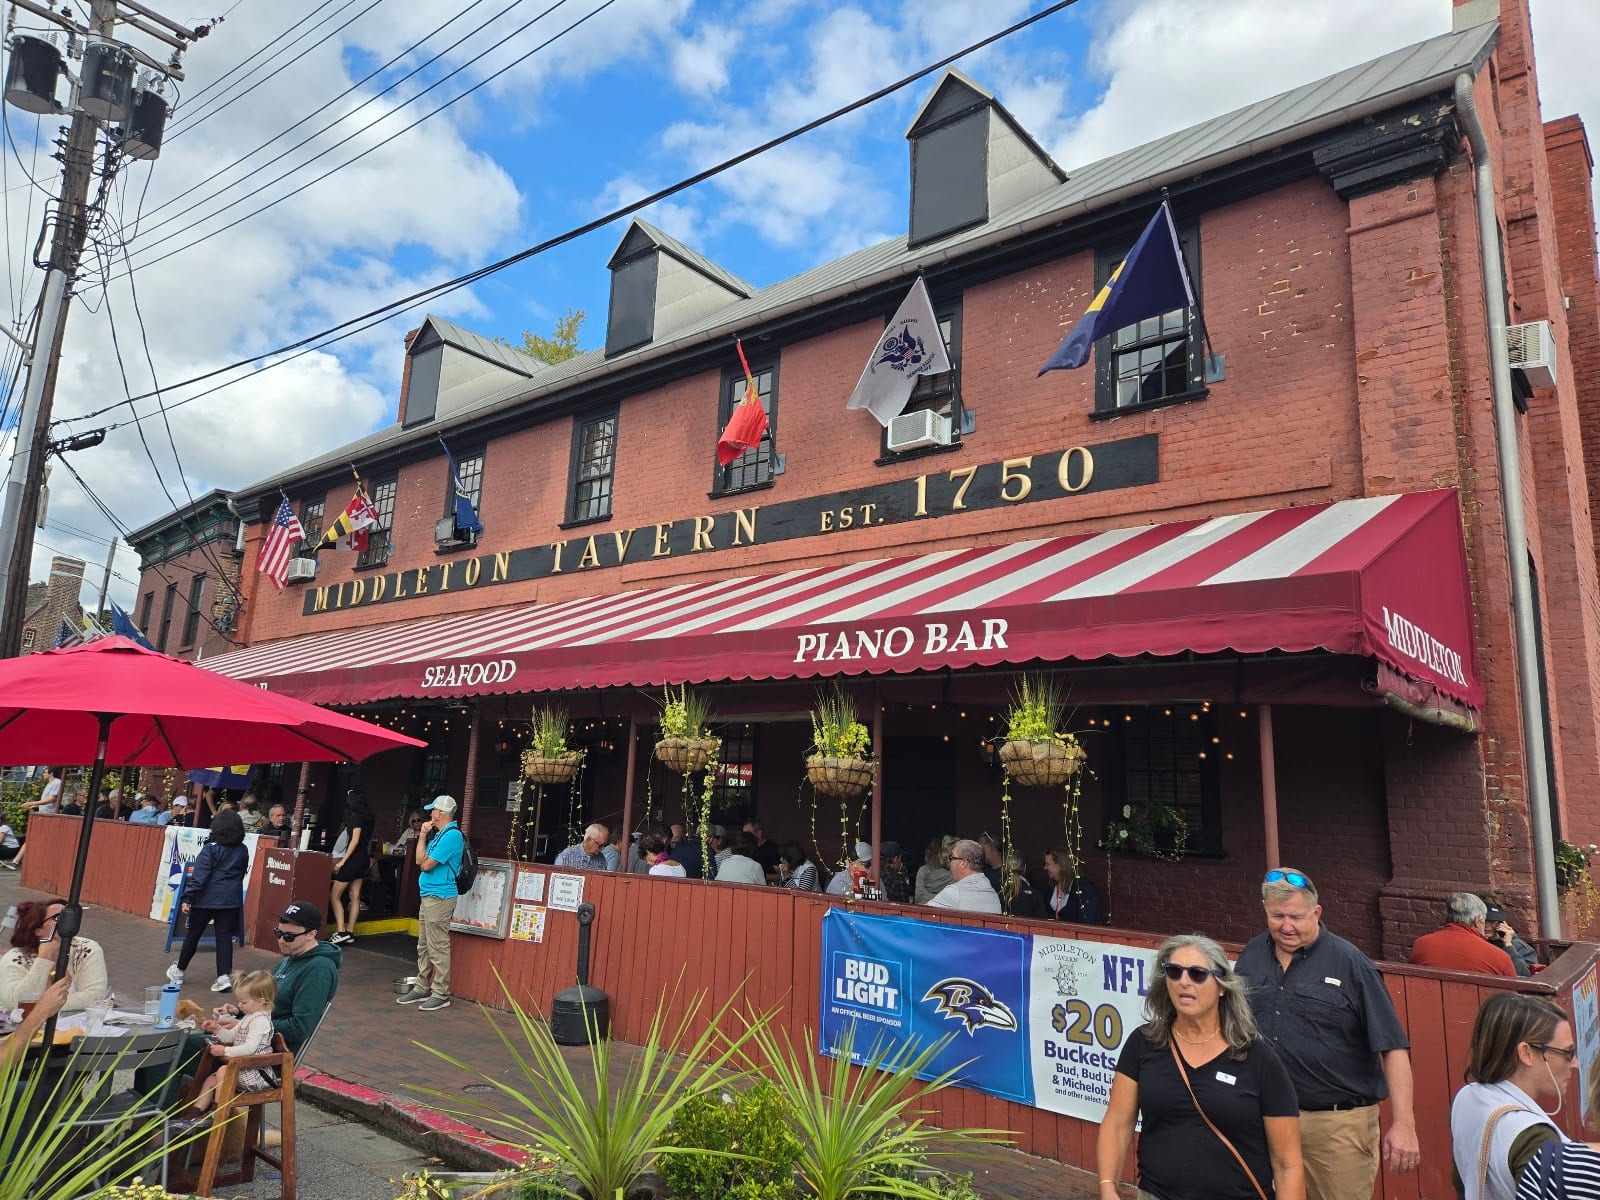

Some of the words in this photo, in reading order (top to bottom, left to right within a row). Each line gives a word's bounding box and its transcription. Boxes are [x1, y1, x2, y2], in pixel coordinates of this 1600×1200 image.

[313, 551, 512, 612] MIDDLETON
[550, 506, 761, 573] TAVERN
[820, 503, 884, 532] EST.
[913, 446, 1094, 517] 1750
[793, 626, 914, 663] PIANO
[922, 618, 1009, 655] BAR
[1382, 605, 1468, 688] MIDDLETON
[421, 659, 517, 688] SEAFOOD
[266, 856, 291, 871] Middleton
[269, 872, 286, 886] Tavern
[1038, 943, 1098, 965] MIDDLETON
[845, 958, 889, 986] BUD
[1103, 953, 1148, 997] NFL
[836, 977, 899, 1010] LIGHT
[831, 1006, 839, 1014] AN
[840, 1008, 862, 1019] OFFICIAL
[862, 1012, 876, 1022] BEER
[876, 1016, 902, 1028] SPONSOR
[1052, 998, 1123, 1051] $20
[1044, 1039, 1117, 1072] Buckets
[1052, 1074, 1060, 1085] &
[1062, 1076, 1107, 1097] Michelob
[1056, 1062, 1079, 1079] Bud,
[1081, 1067, 1102, 1082] Bud
[1103, 1072, 1113, 1085] Li
[1055, 1088, 1067, 1096] and
[1067, 1090, 1083, 1100] other
[1084, 1094, 1102, 1104] select
